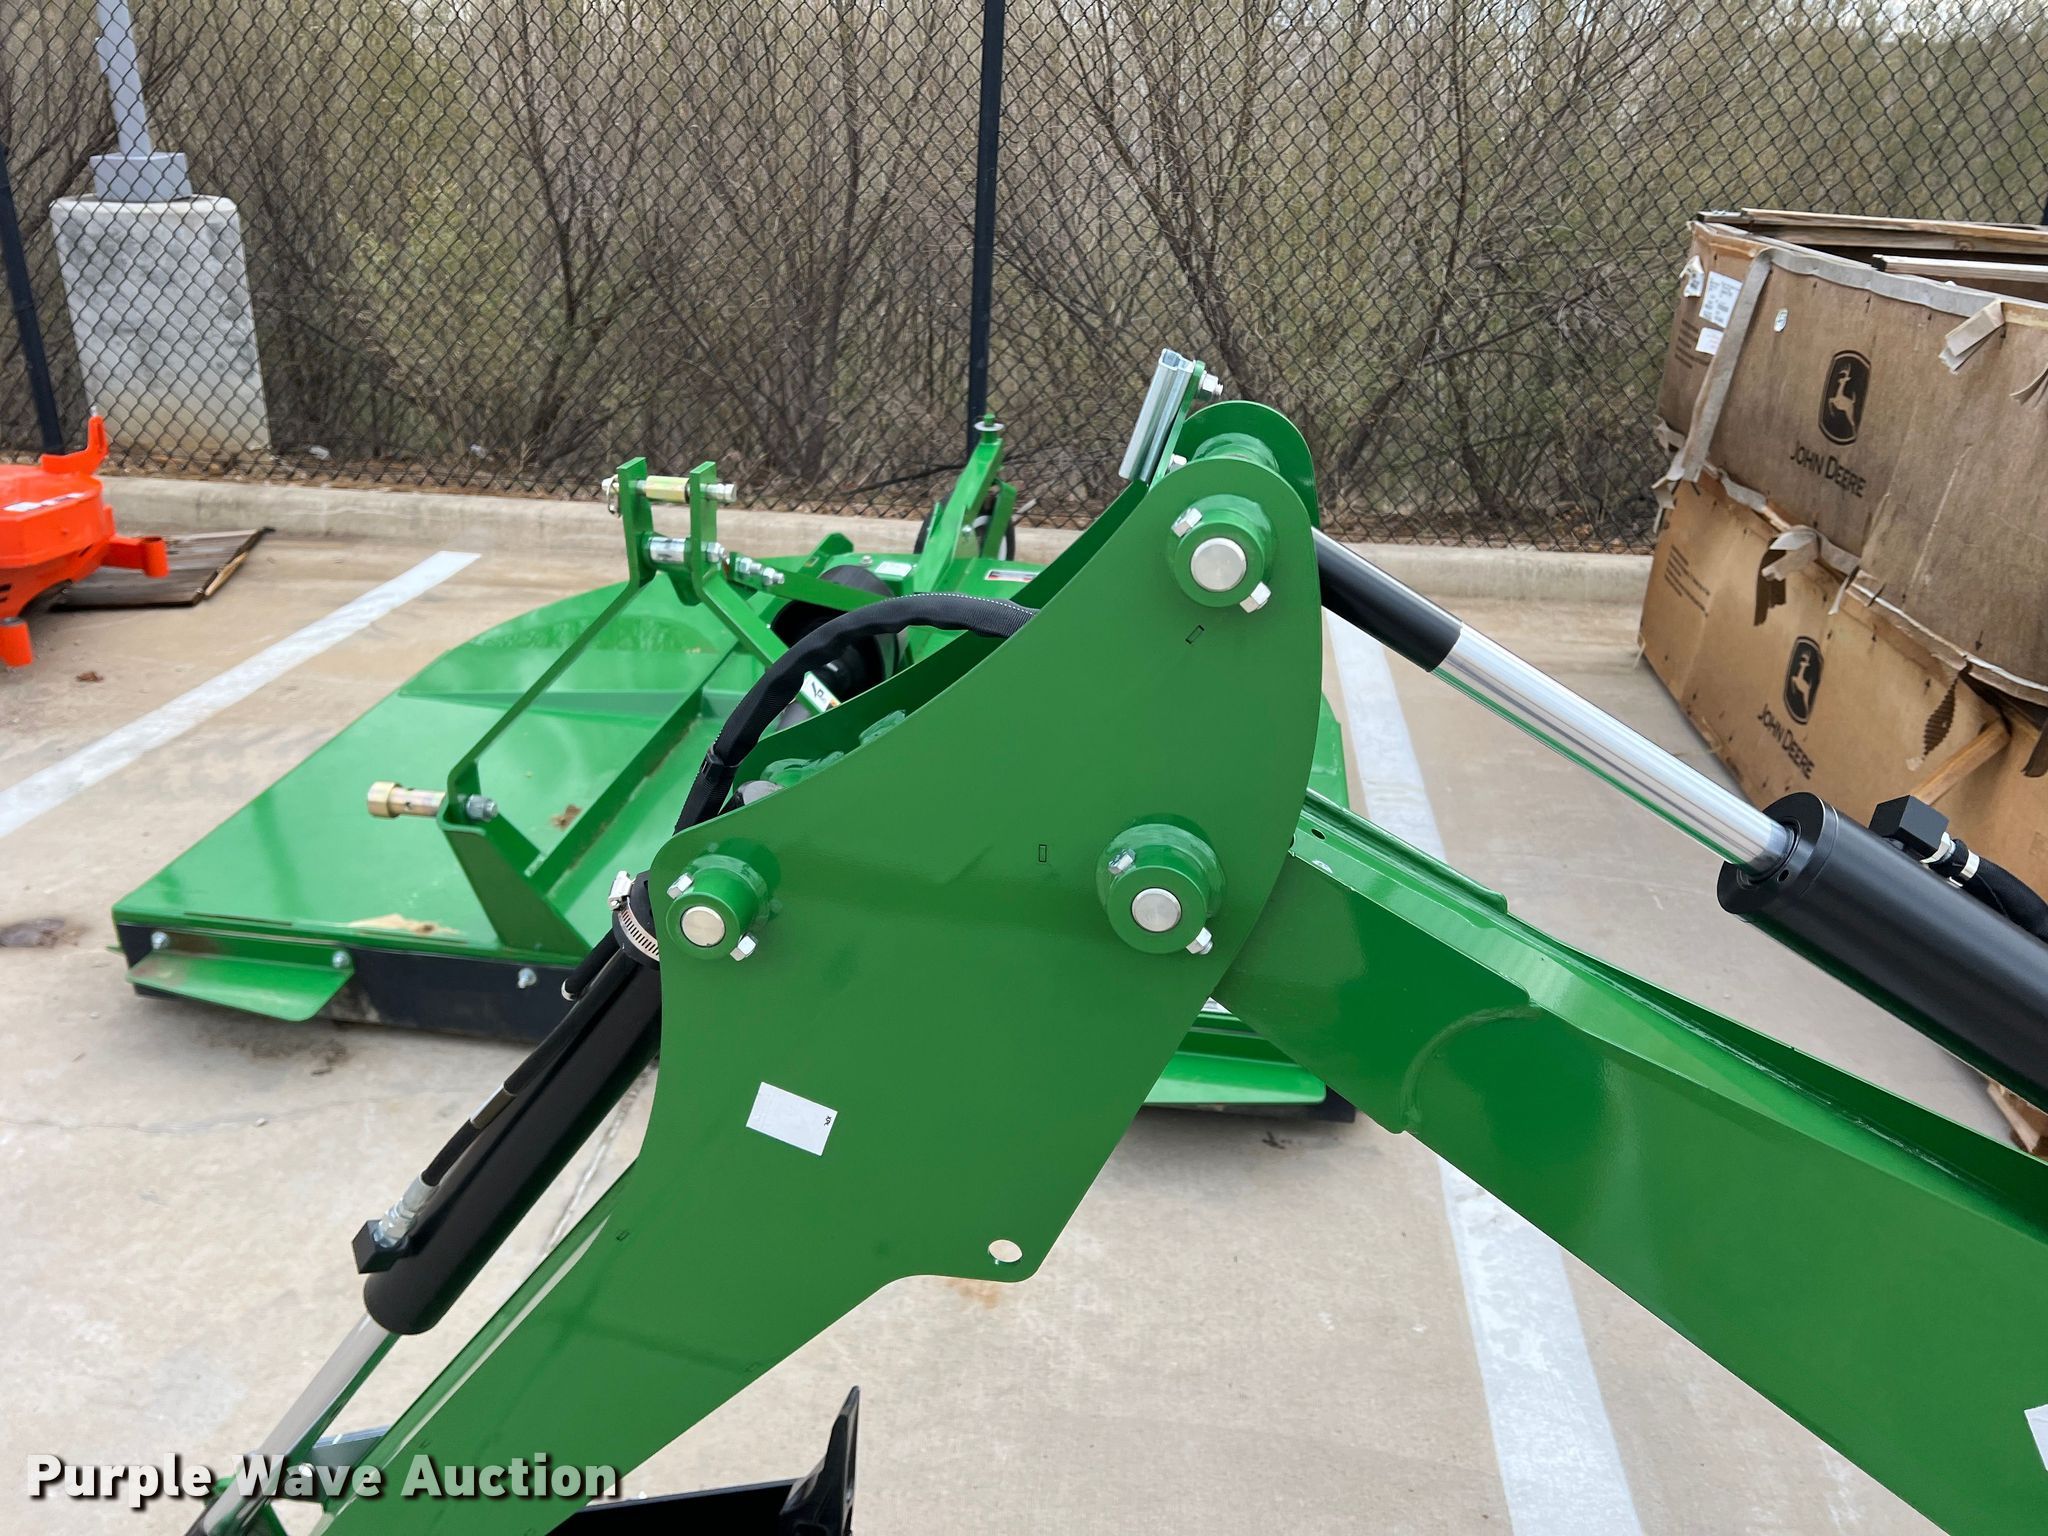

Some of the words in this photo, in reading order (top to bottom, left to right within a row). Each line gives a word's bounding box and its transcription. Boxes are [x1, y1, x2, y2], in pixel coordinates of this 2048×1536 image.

[1790, 440, 1825, 475] JOHN
[1825, 454, 1866, 498] DEERE
[1757, 703, 1785, 743] JOHN
[1782, 728, 1815, 780] DEERE
